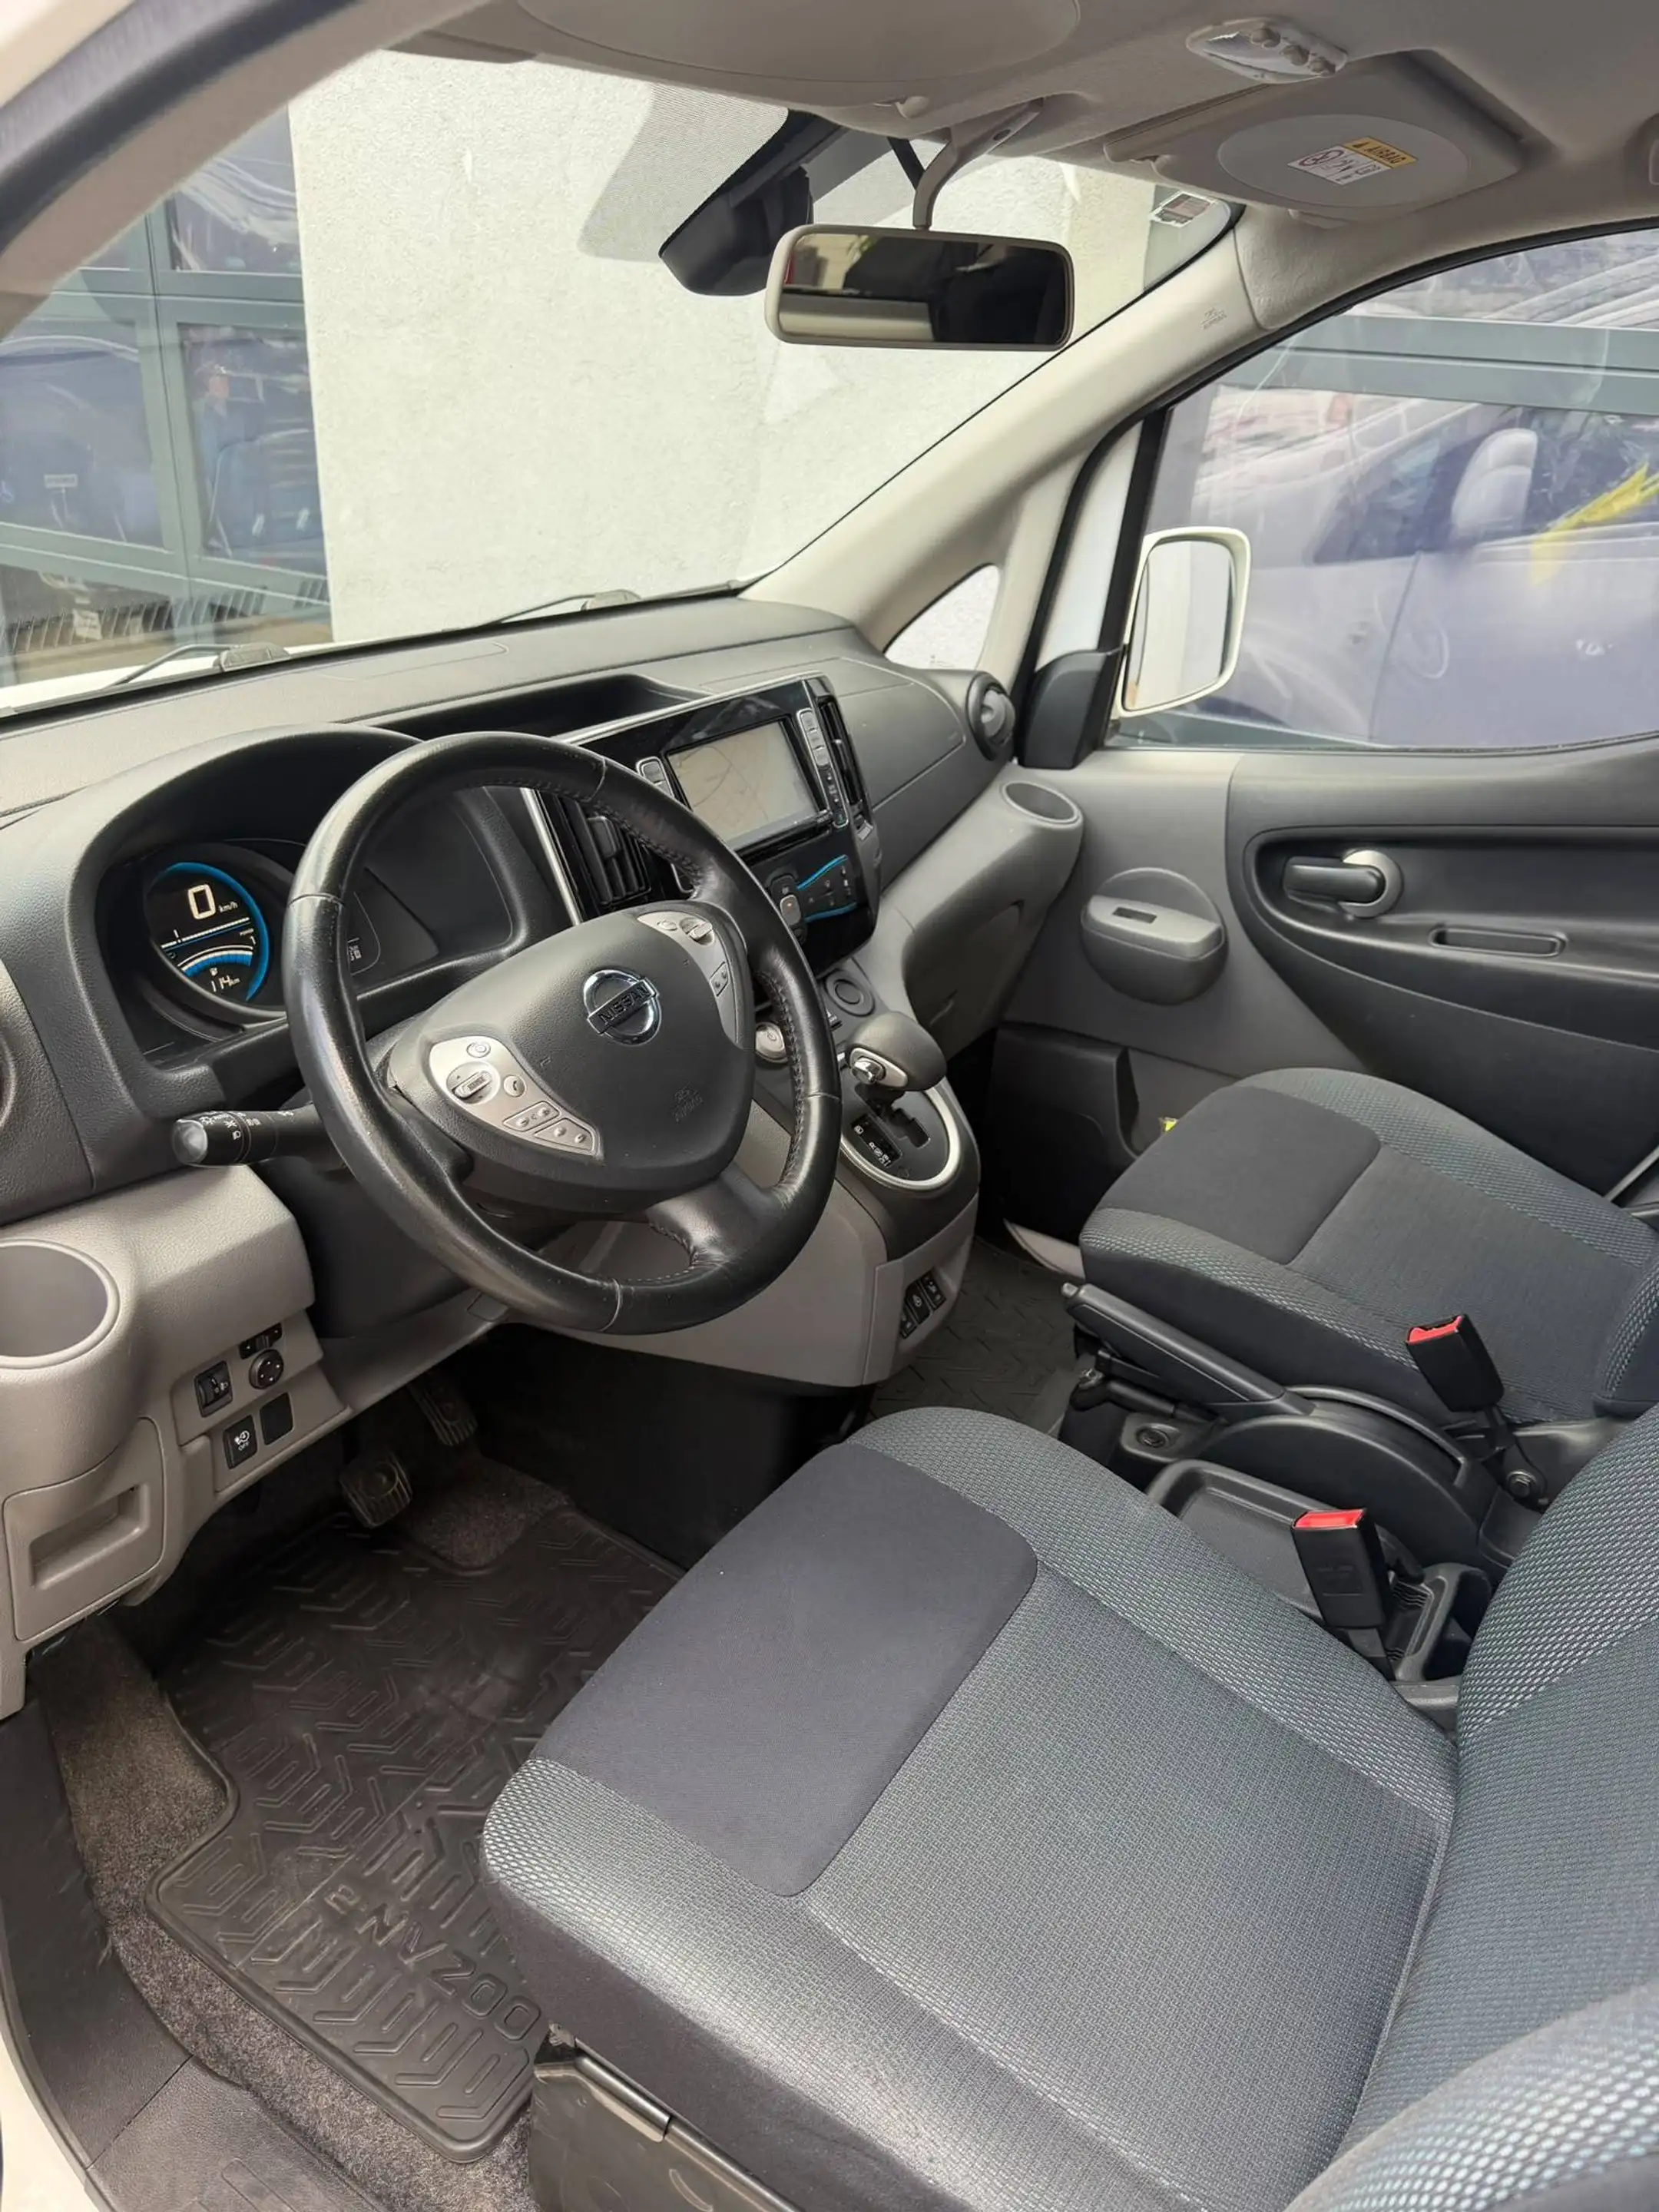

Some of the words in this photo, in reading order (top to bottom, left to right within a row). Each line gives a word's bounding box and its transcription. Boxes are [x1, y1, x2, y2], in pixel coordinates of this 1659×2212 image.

[187, 883, 216, 920] 0
[218, 901, 238, 913] km/h
[599, 982, 652, 1027] NISSAN
